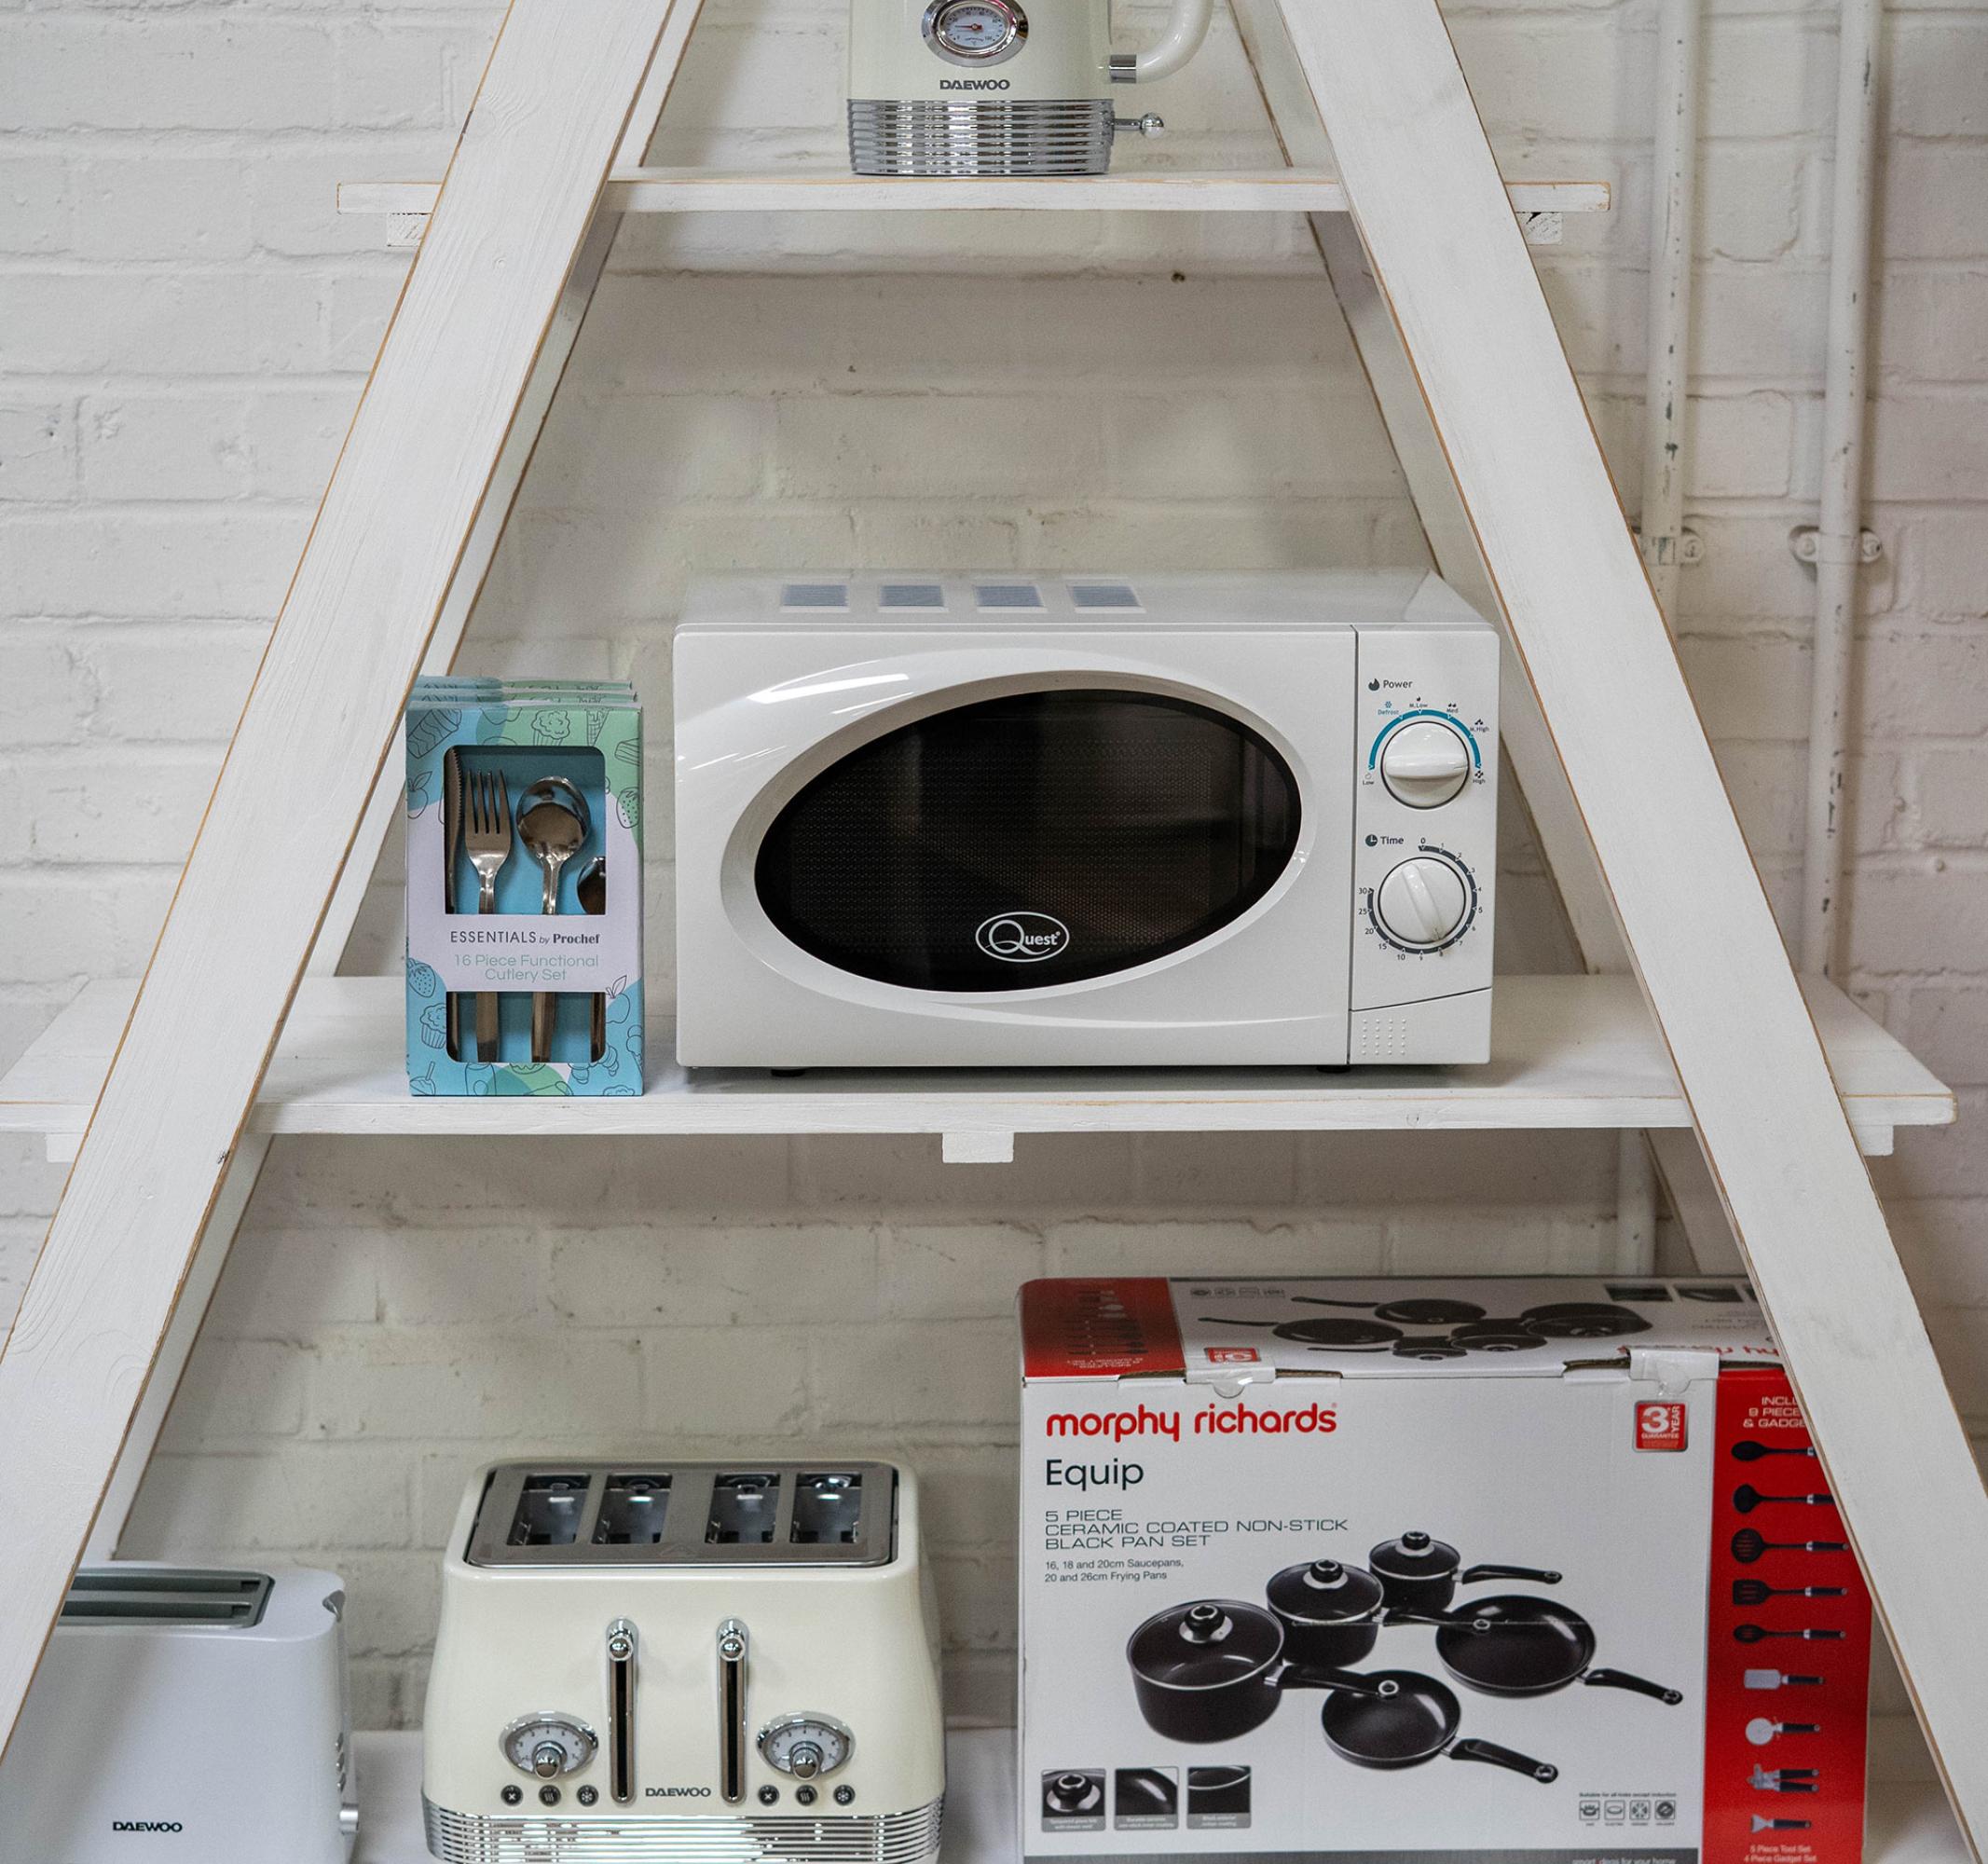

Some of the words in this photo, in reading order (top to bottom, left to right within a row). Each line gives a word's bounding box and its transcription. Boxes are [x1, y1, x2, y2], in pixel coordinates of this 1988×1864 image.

[939, 79, 1010, 90] DAEWOO
[1383, 679, 1413, 689] Power
[1380, 836, 1404, 844] Time
[450, 930, 537, 944] ESSENTIALS
[539, 935, 550, 945] by
[553, 933, 601, 944] Prochef
[986, 919, 1060, 955] Quest
[454, 954, 472, 967] 16
[475, 954, 517, 967] Piece
[520, 954, 599, 967] Functional
[485, 967, 539, 981] Cutlery
[541, 968, 567, 980] Set
[1047, 1404, 1180, 1443] morphy
[1194, 1402, 1337, 1434] richards
[1641, 1406, 1669, 1432] 3
[1671, 1405, 1680, 1432] YEAR
[1743, 1418, 1754, 1428] &
[1758, 1418, 1806, 1428] GADGE
[1046, 1458, 1144, 1491] Equip
[1045, 1510, 1059, 1522] 5
[1066, 1509, 1123, 1522] PIECE
[1045, 1522, 1139, 1536] CERAMIC
[1146, 1521, 1228, 1534] COATED
[1237, 1519, 1348, 1532] NON-STICK
[1046, 1536, 1114, 1550] BLACK
[1121, 1536, 1164, 1548] PAN
[1172, 1534, 1211, 1547] SET
[1046, 1561, 1059, 1571] 16,
[1063, 1561, 1073, 1569] 18
[1076, 1560, 1094, 1569] and
[1097, 1559, 1124, 1569] 20cm
[1127, 1558, 1184, 1569] Saucepans,
[1044, 1573, 1057, 1583] 20
[1060, 1573, 1077, 1582] and
[1080, 1572, 1107, 1582] 26cm
[1110, 1571, 1140, 1583] Frying
[1143, 1570, 1167, 1580] Pans
[645, 1788, 711, 1797] DAEWOO
[113, 1821, 183, 1832] DAEWOO
[1757, 1844, 1779, 1853] Piece
